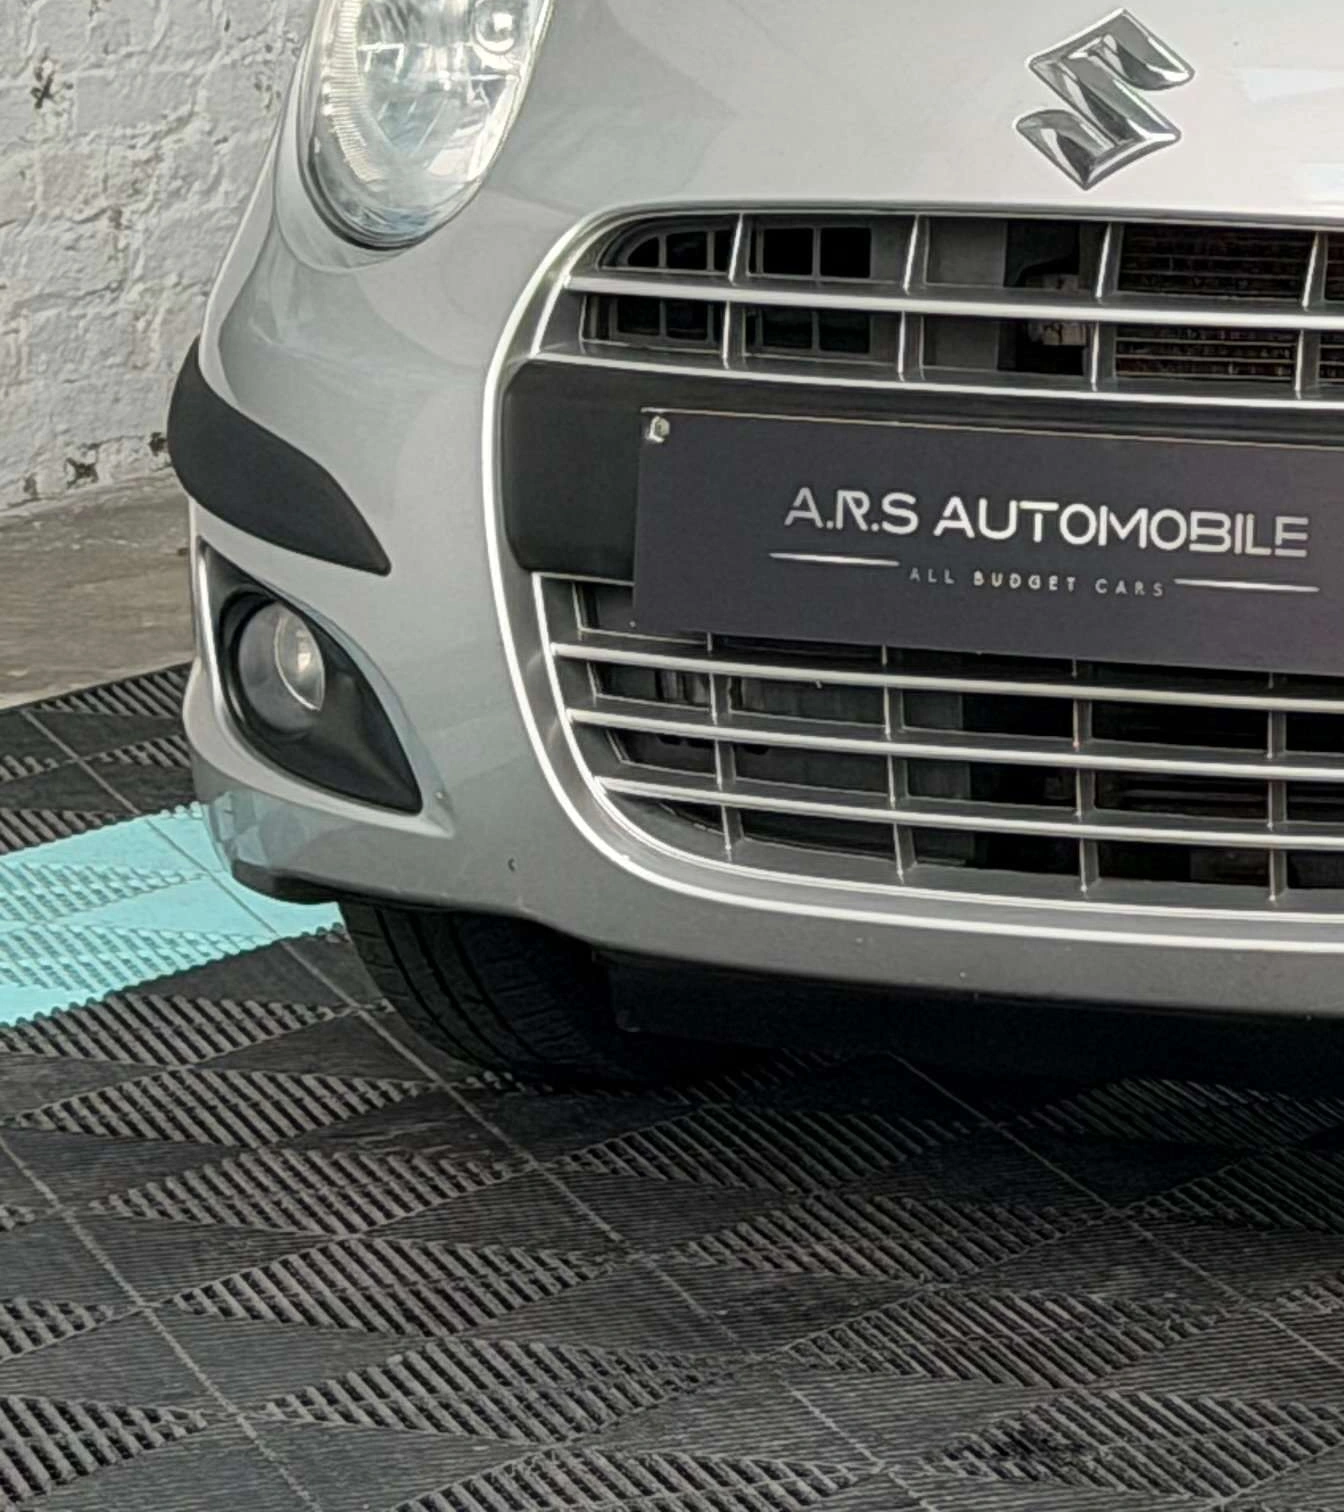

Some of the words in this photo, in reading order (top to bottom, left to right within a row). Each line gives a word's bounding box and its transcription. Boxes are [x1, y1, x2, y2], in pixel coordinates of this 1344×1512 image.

[784, 486, 919, 536] A.R.S
[932, 495, 1310, 558] AUTOMOBILE
[909, 567, 955, 585] ALL
[973, 569, 1077, 593] BUDGET
[1094, 578, 1165, 597] CARS
